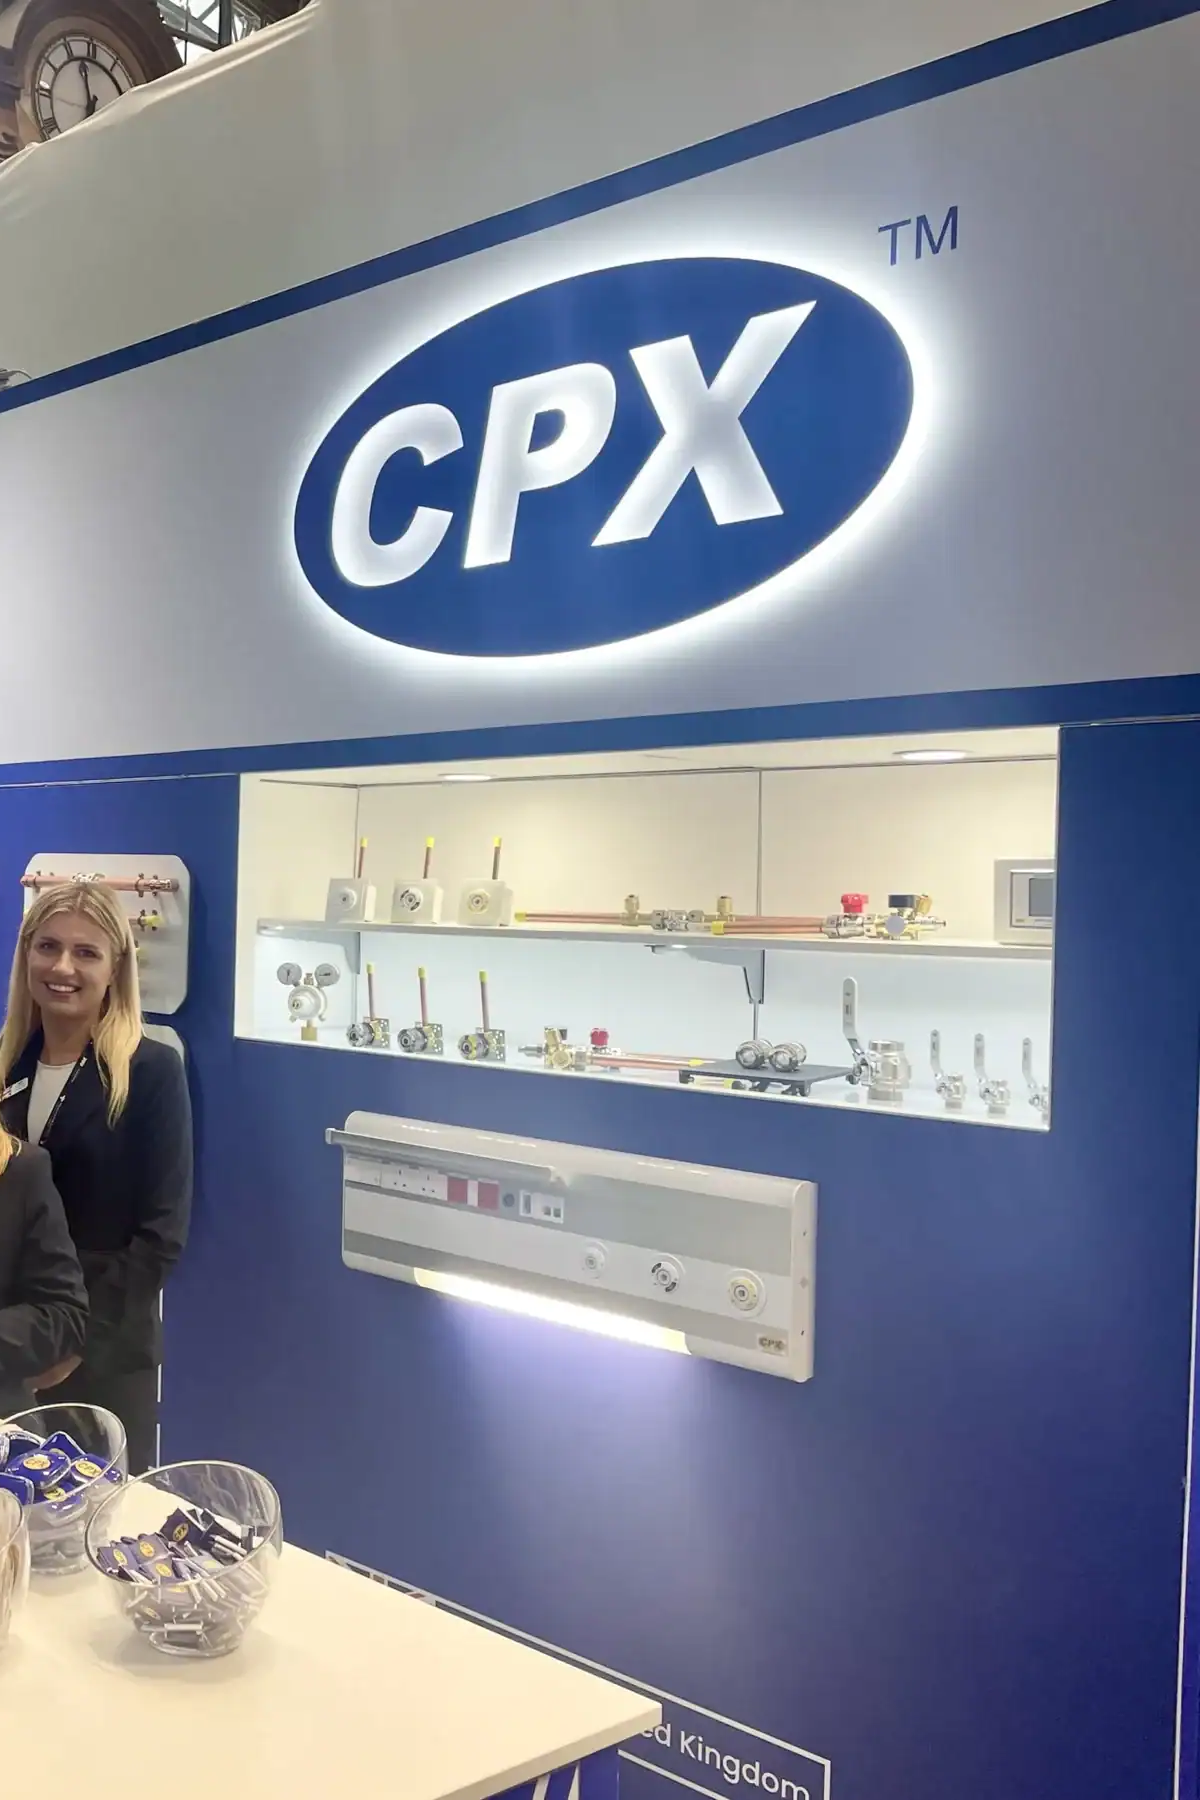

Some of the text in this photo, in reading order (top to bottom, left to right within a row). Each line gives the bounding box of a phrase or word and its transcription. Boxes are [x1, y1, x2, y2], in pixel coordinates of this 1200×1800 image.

[878, 205, 959, 266] TM
[331, 299, 817, 588] CPX
[680, 1730, 809, 1800] Kingdom
